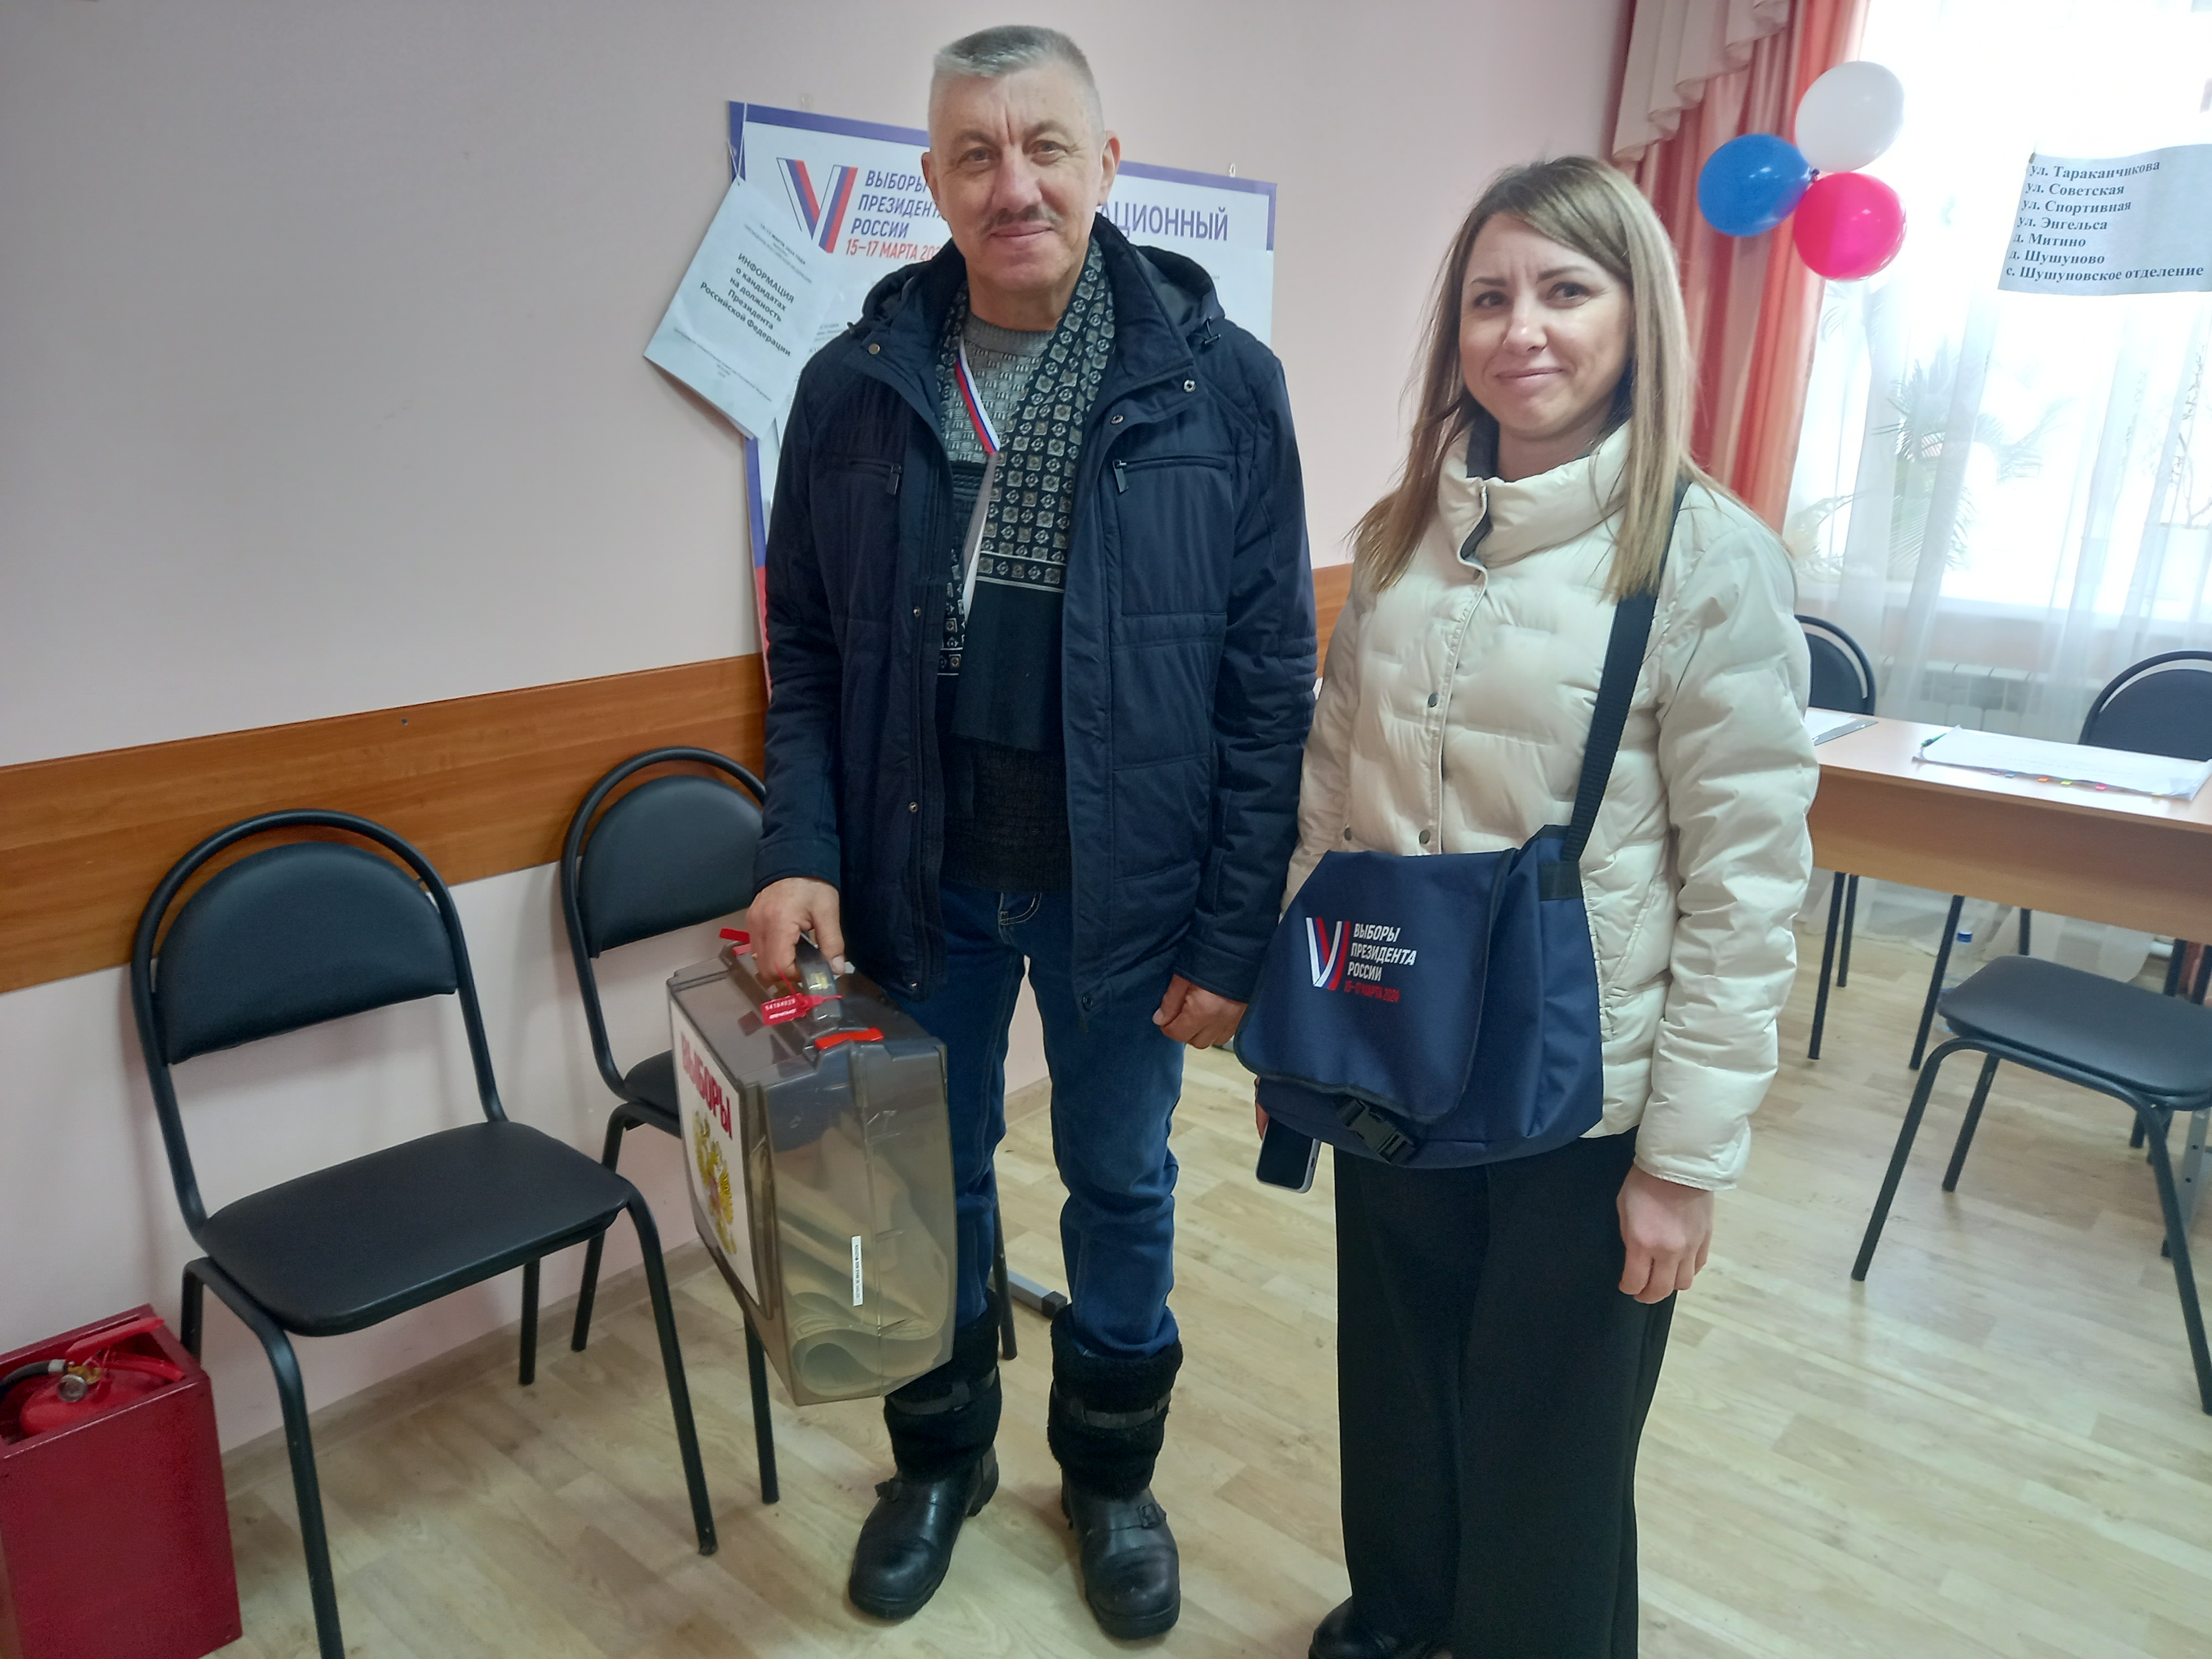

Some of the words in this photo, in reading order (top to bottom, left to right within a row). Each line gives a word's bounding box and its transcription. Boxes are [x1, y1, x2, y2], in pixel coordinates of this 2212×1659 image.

[2030, 164, 2048, 176] ул.
[2053, 161, 2160, 181] Тараканчикова
[2025, 182, 2044, 194] ул.
[2049, 182, 2125, 196] Советская
[858, 194, 942, 218] ПРЕЗИДЕН
[2021, 200, 2040, 211] ул.
[2045, 200, 2132, 216] Спортивная
[851, 217, 910, 238] РОССИИ
[2017, 216, 2036, 228] ул.
[2041, 217, 2107, 230] Энгельса
[879, 241, 918, 260] МАРТА
[2013, 233, 2024, 243] д.
[2028, 233, 2086, 248] Митино
[2008, 250, 2020, 260] д.
[2024, 250, 2105, 267] Шушуново
[738, 253, 795, 304] ИНФОРМАЦИЯ
[2006, 268, 2015, 276] с.
[2020, 266, 2121, 283] Шушуновское
[2125, 266, 2204, 279] отделение
[730, 277, 740, 288] на
[740, 286, 782, 322] должность
[742, 272, 786, 311] кандидатах
[700, 281, 746, 322] Российской
[747, 319, 791, 357] Федерации
[728, 289, 774, 330] Президента
[1353, 922, 1401, 942] ВЫБОРЫ
[1350, 942, 1417, 966] ПРЕЗИДЕНТА
[1347, 961, 1383, 982] РОССИИ
[681, 1030, 733, 1141] ВЫБОРЫ
